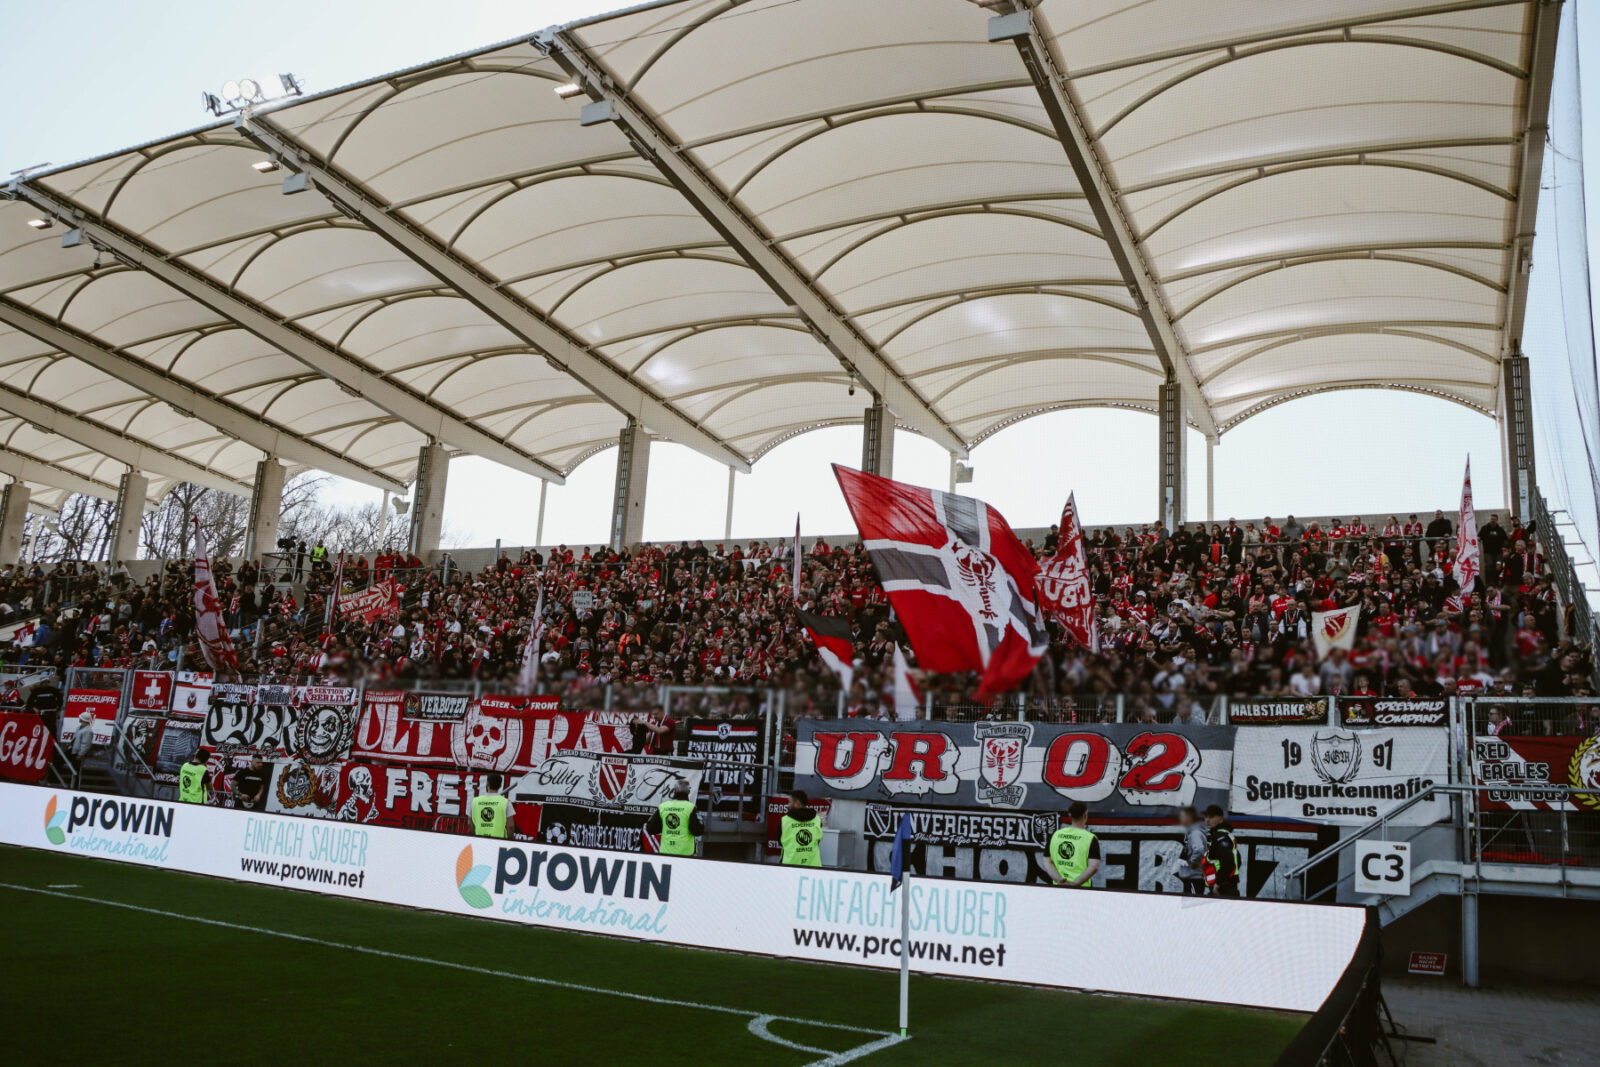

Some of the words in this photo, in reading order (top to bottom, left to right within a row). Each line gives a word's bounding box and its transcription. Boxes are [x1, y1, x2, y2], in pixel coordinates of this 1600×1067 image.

[68, 694, 118, 705] REISEGRUPPE
[311, 694, 347, 703] BERLIN
[314, 687, 344, 695] SEKTION
[421, 695, 469, 714] VERBOTEN
[481, 699, 510, 709] ELSTER
[530, 701, 559, 711] FRONT
[1231, 703, 1304, 717] HALBSTARKE
[1374, 701, 1445, 712] SPREEWALD
[1374, 713, 1444, 725] COMPANY
[982, 726, 1006, 737] ULTIMA
[688, 740, 757, 753] PSEUDOFANS
[1281, 738, 1302, 769] 19
[1475, 741, 1511, 761] RED
[812, 730, 962, 797] UR
[1042, 731, 1202, 806] 02
[1480, 761, 1551, 781] EAGLES
[1246, 774, 1436, 802] Senfgurkenmafia
[70, 828, 170, 863] international
[243, 817, 305, 858] EINFACH
[309, 824, 369, 867] SAUBER
[1361, 852, 1405, 882] C3
[501, 888, 668, 935] international
[795, 875, 897, 929] EINFACH
[909, 884, 1008, 940] SAUBER
